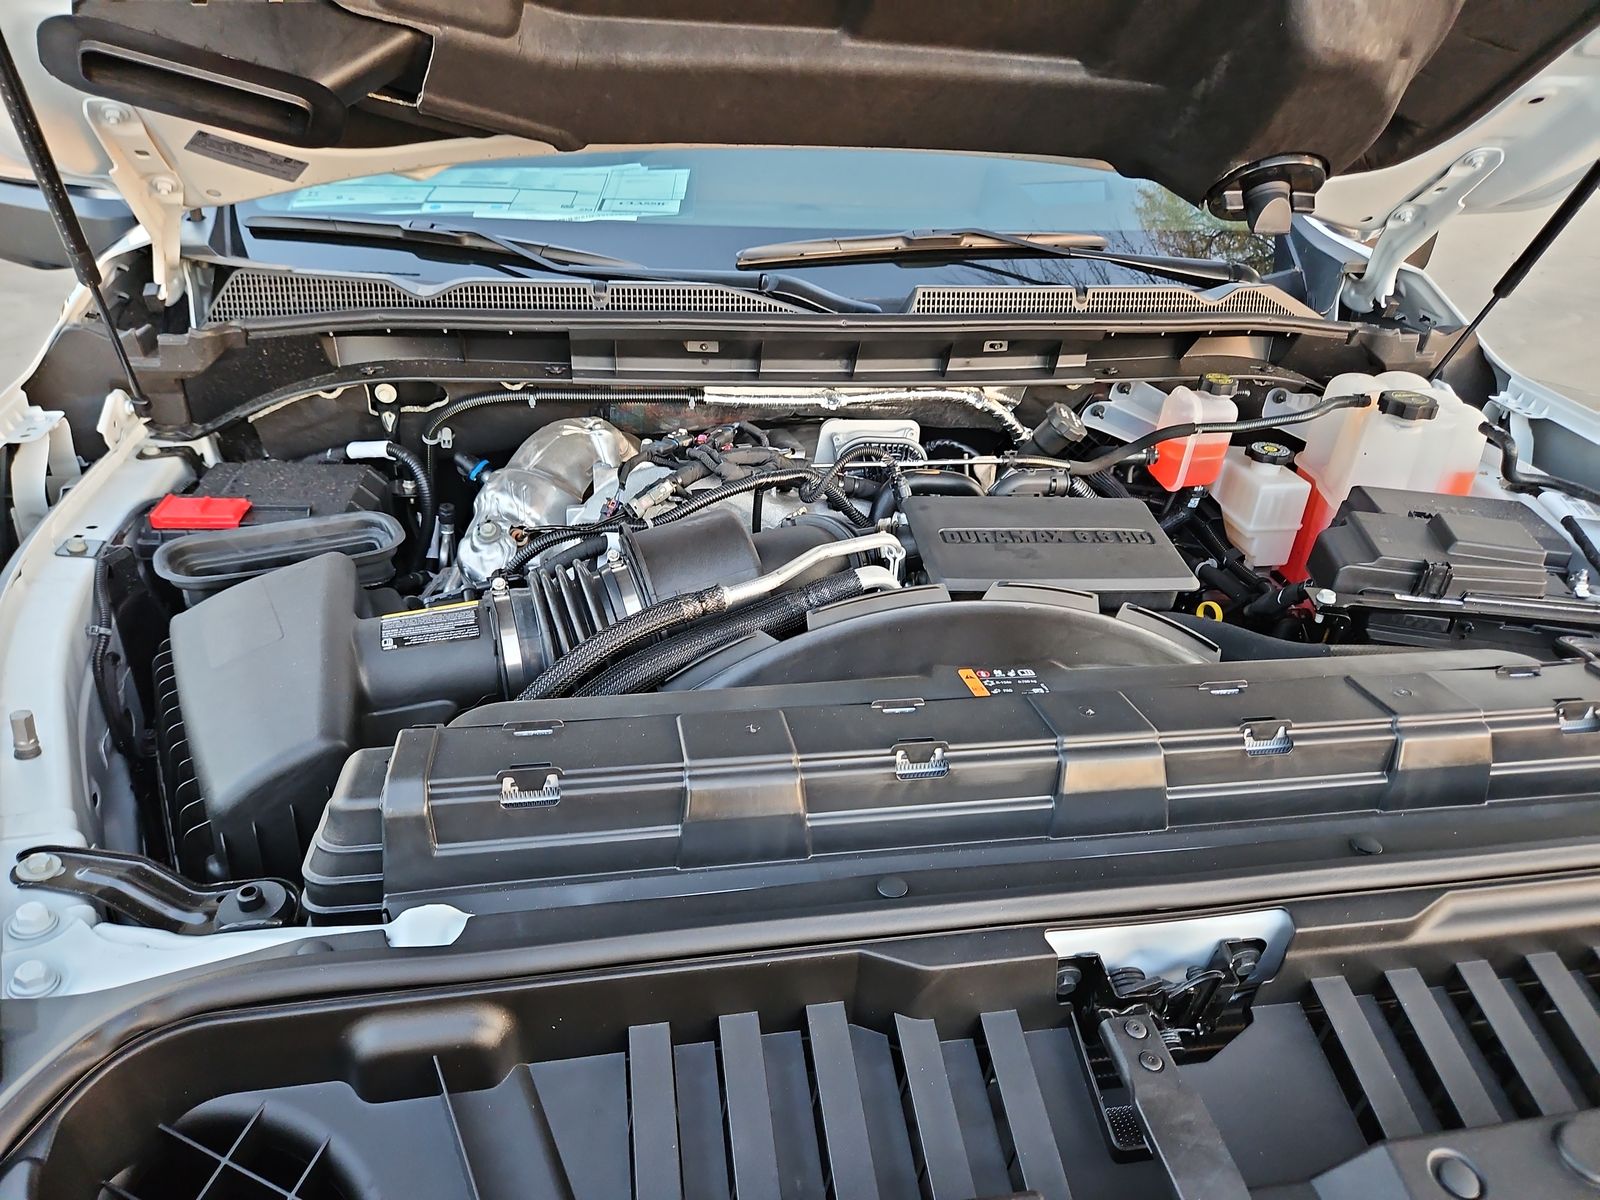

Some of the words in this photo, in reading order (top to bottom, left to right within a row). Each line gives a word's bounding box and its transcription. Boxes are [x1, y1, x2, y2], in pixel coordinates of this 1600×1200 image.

[943, 530, 1064, 543] DURAMAX
[1073, 530, 1115, 543] 6.6
[1119, 531, 1154, 544] HD
